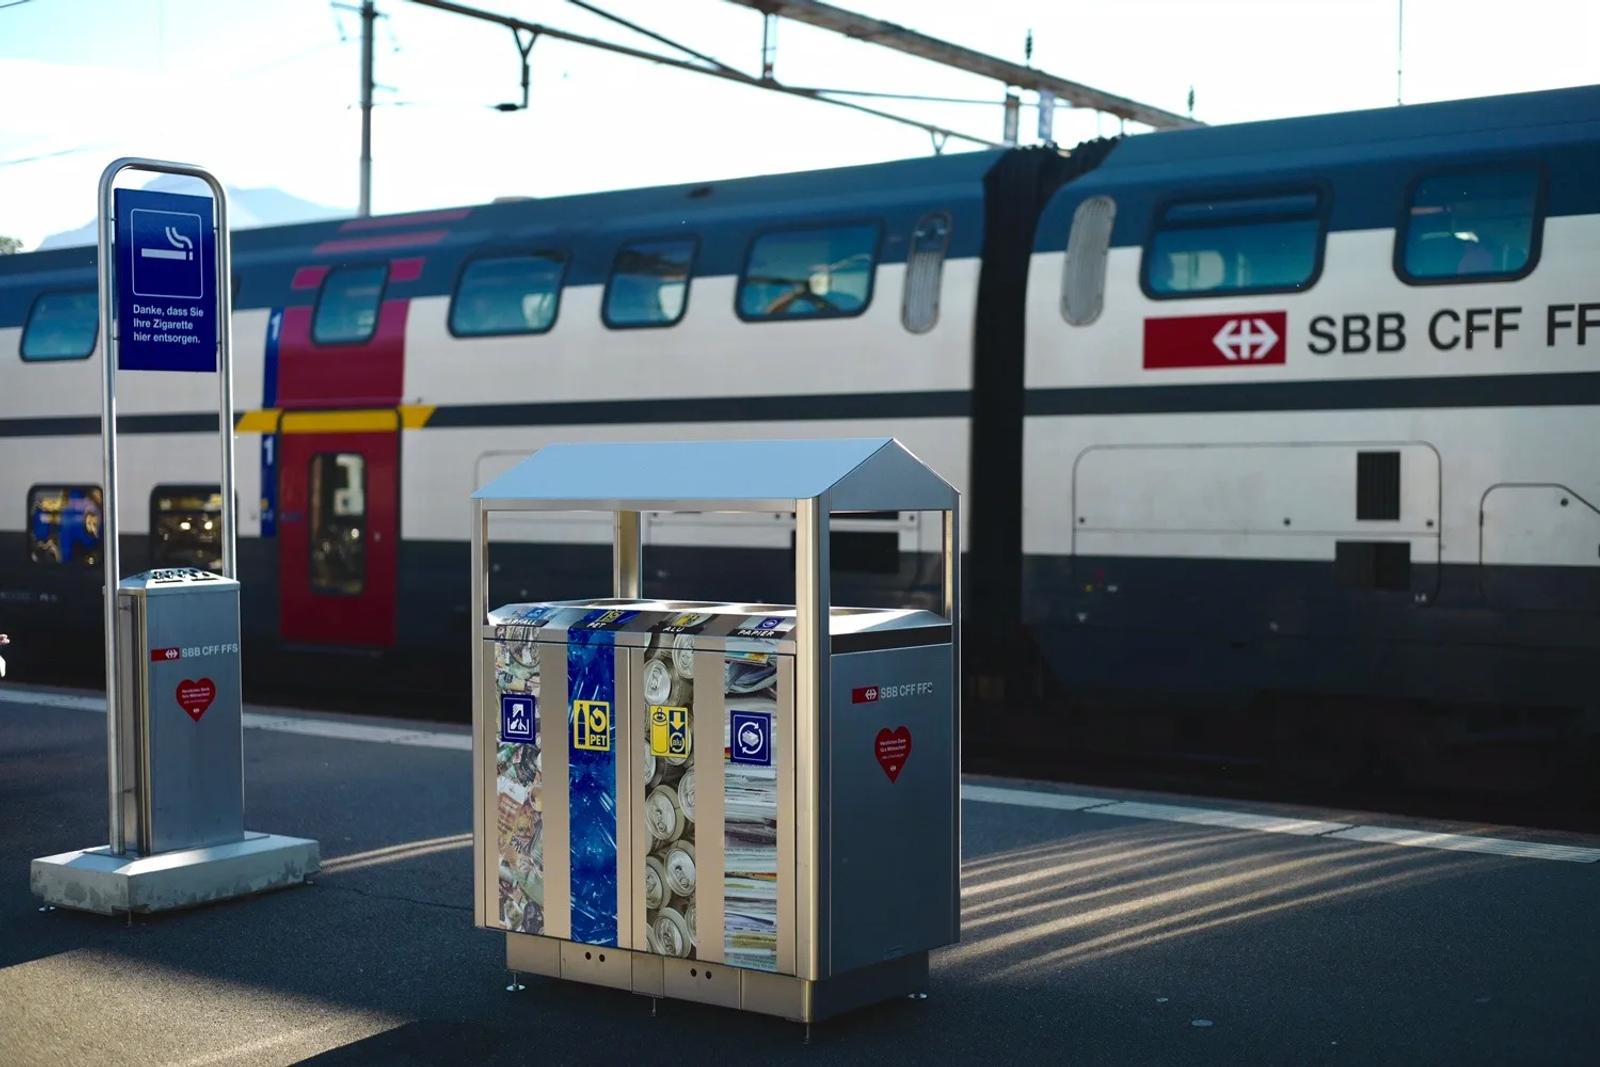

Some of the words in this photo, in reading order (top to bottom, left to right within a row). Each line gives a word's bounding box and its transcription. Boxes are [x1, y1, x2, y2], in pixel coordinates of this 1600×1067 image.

[133, 304, 165, 316] Danke,
[167, 306, 188, 316] dass
[190, 306, 204, 317] Sie
[133, 318, 151, 328] Ihre
[153, 318, 194, 331] Zigarette
[270, 313, 281, 340] 1
[1306, 313, 1407, 355] SBB
[1428, 307, 1523, 352] CFF
[133, 331, 151, 341] hier
[153, 333, 201, 345] entsorgen.
[264, 436, 274, 466] 1
[737, 629, 775, 637] PAPIER
[181, 647, 201, 658] SBB
[202, 645, 220, 656] CFF
[221, 643, 238, 654] FFS
[880, 685, 898, 699] SBB
[899, 683, 916, 697] CFF
[590, 734, 607, 746] PET
